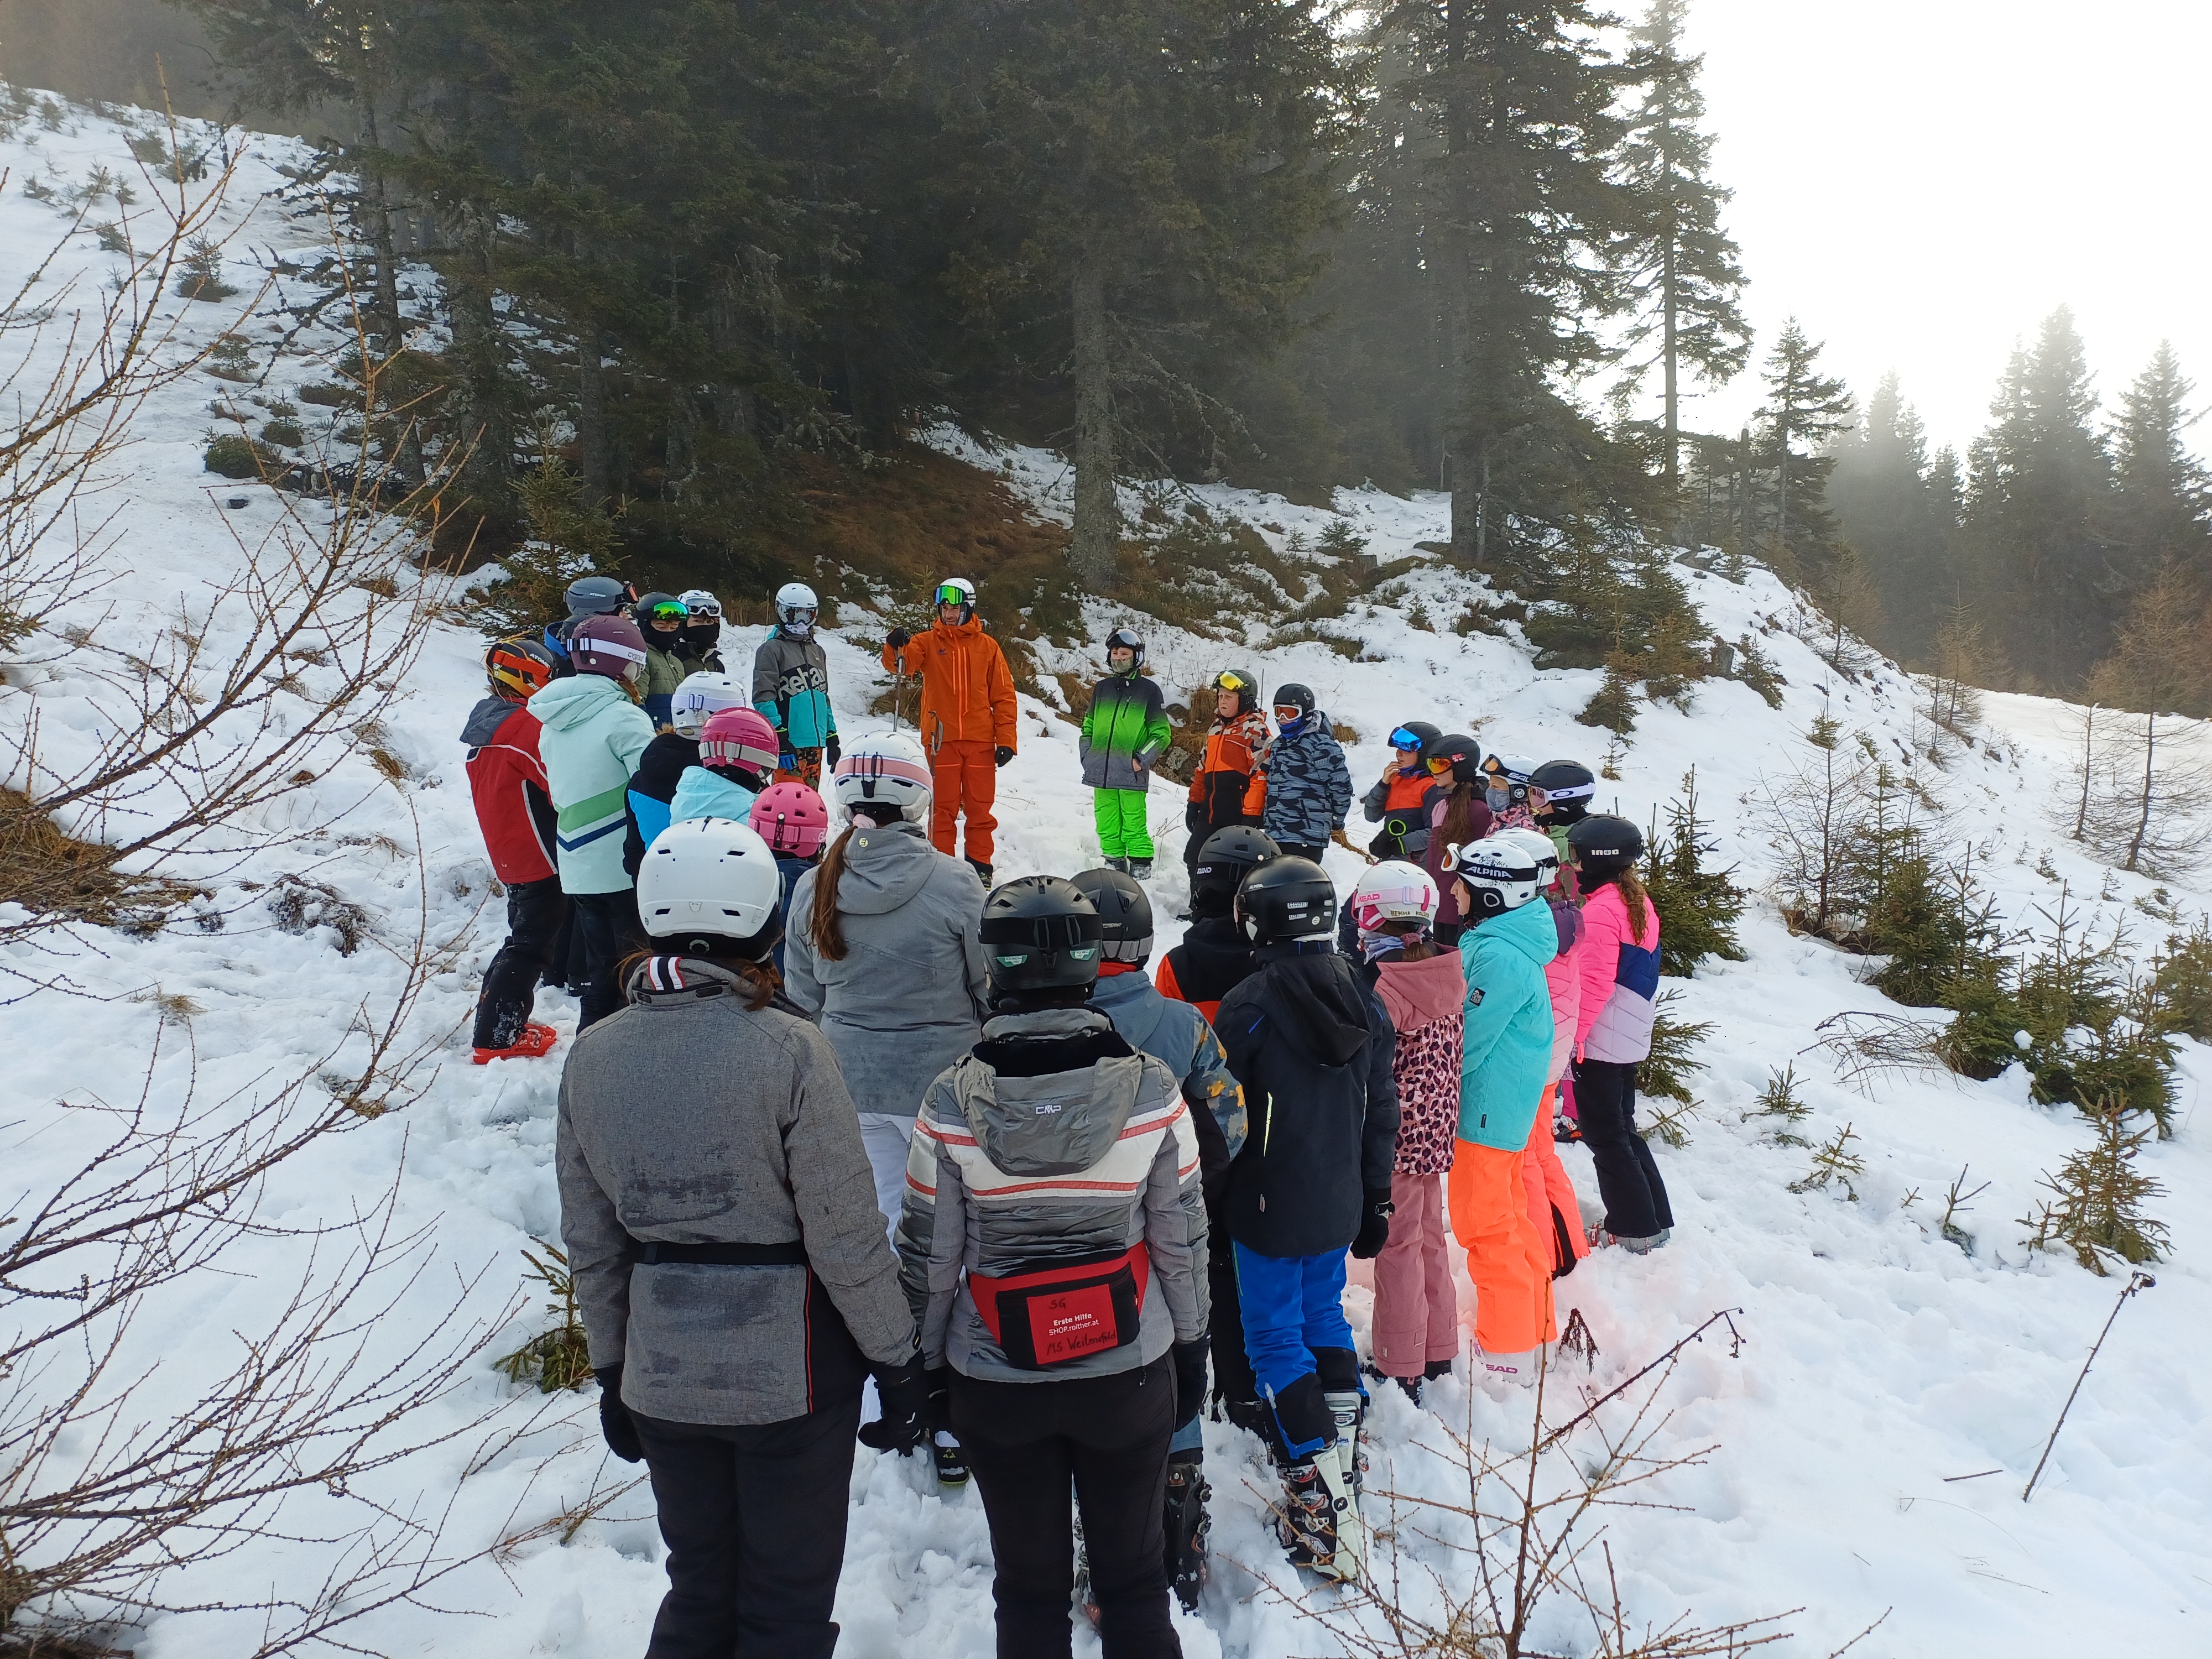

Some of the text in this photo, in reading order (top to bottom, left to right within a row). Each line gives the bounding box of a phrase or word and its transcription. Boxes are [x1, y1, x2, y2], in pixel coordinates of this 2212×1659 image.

[1507, 772, 1530, 782] SAL
[1465, 866, 1514, 878] ALPINA
[1357, 893, 1380, 903] HEAD
[1036, 1105, 1061, 1114] CMP
[1048, 1297, 1066, 1310] SG
[1053, 1313, 1092, 1326] Erste Hilfe
[1048, 1319, 1099, 1335] SHOP.roither.at
[1047, 1342, 1063, 1356] MS
[1485, 1364, 1518, 1374] EAD
